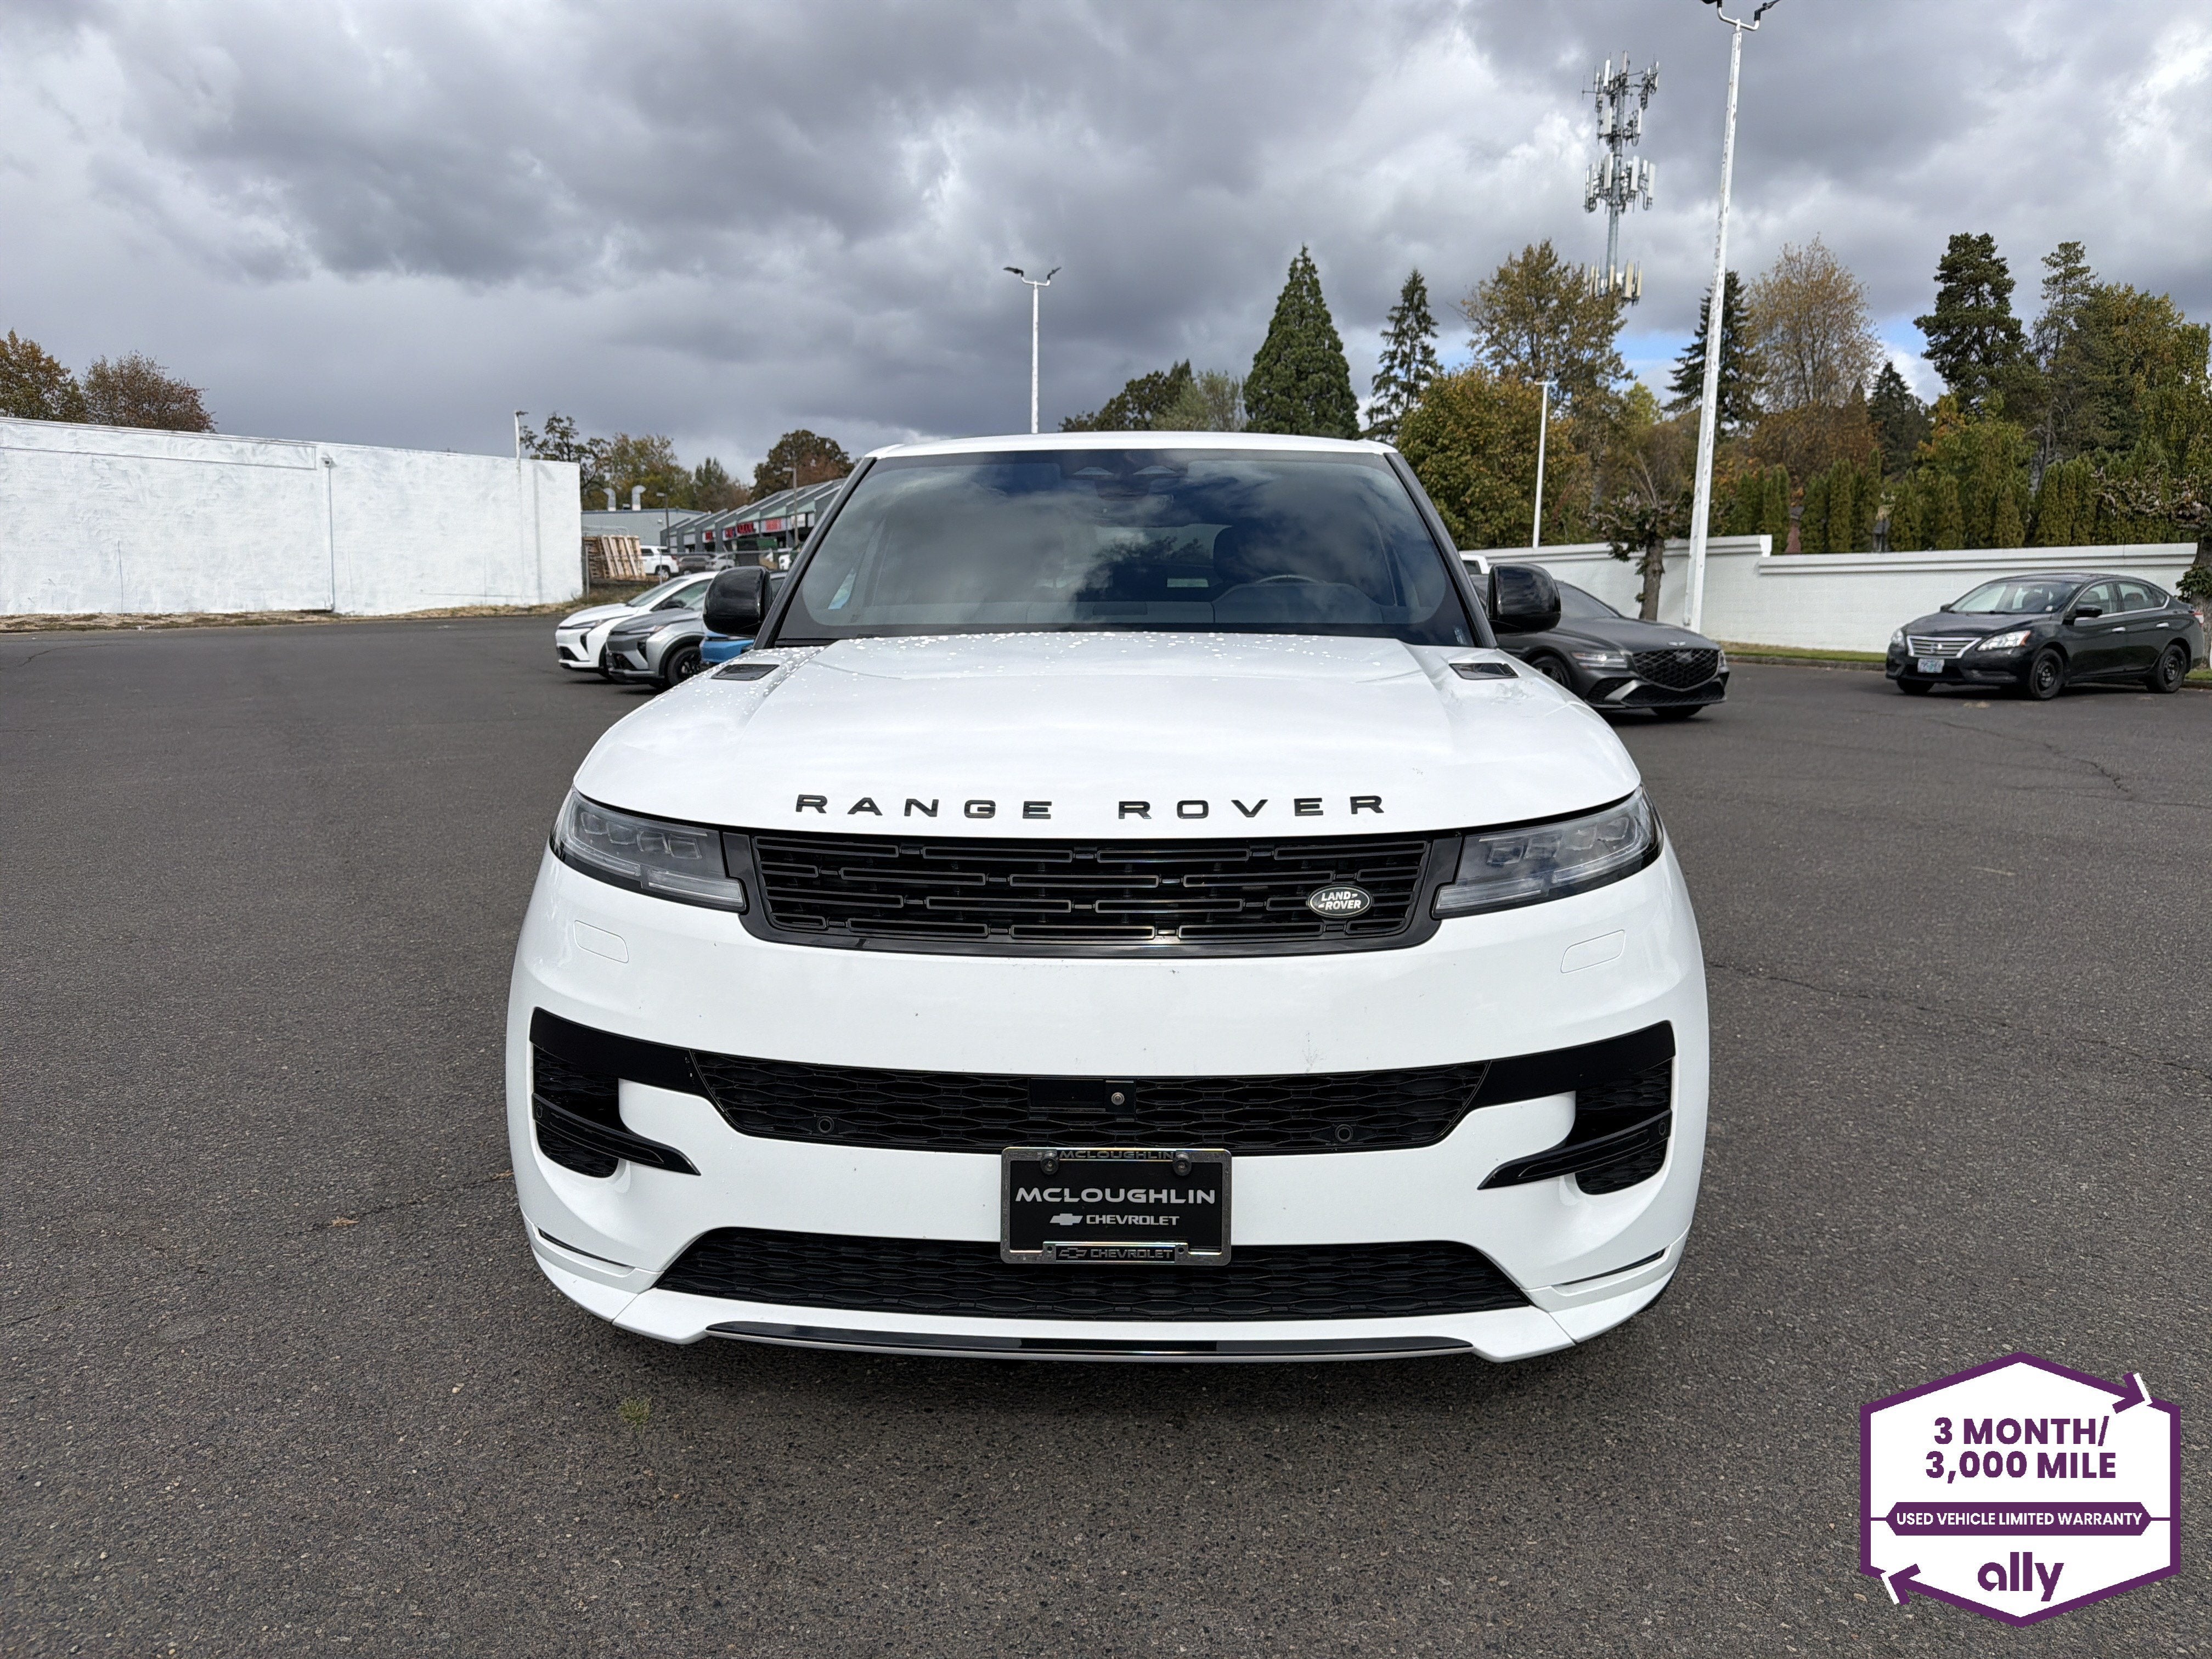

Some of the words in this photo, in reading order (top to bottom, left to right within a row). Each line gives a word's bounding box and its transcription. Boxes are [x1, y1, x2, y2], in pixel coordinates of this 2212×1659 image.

[795, 794, 1052, 820] RANGE
[1118, 795, 1385, 820] ROVER
[1059, 1150, 1174, 1159] MCLOUGHLIN
[1015, 1187, 1216, 1205] MCLOUGHLIN
[1086, 1214, 1180, 1226] CHEVROLET
[1090, 1249, 1173, 1259] CHEVROLET
